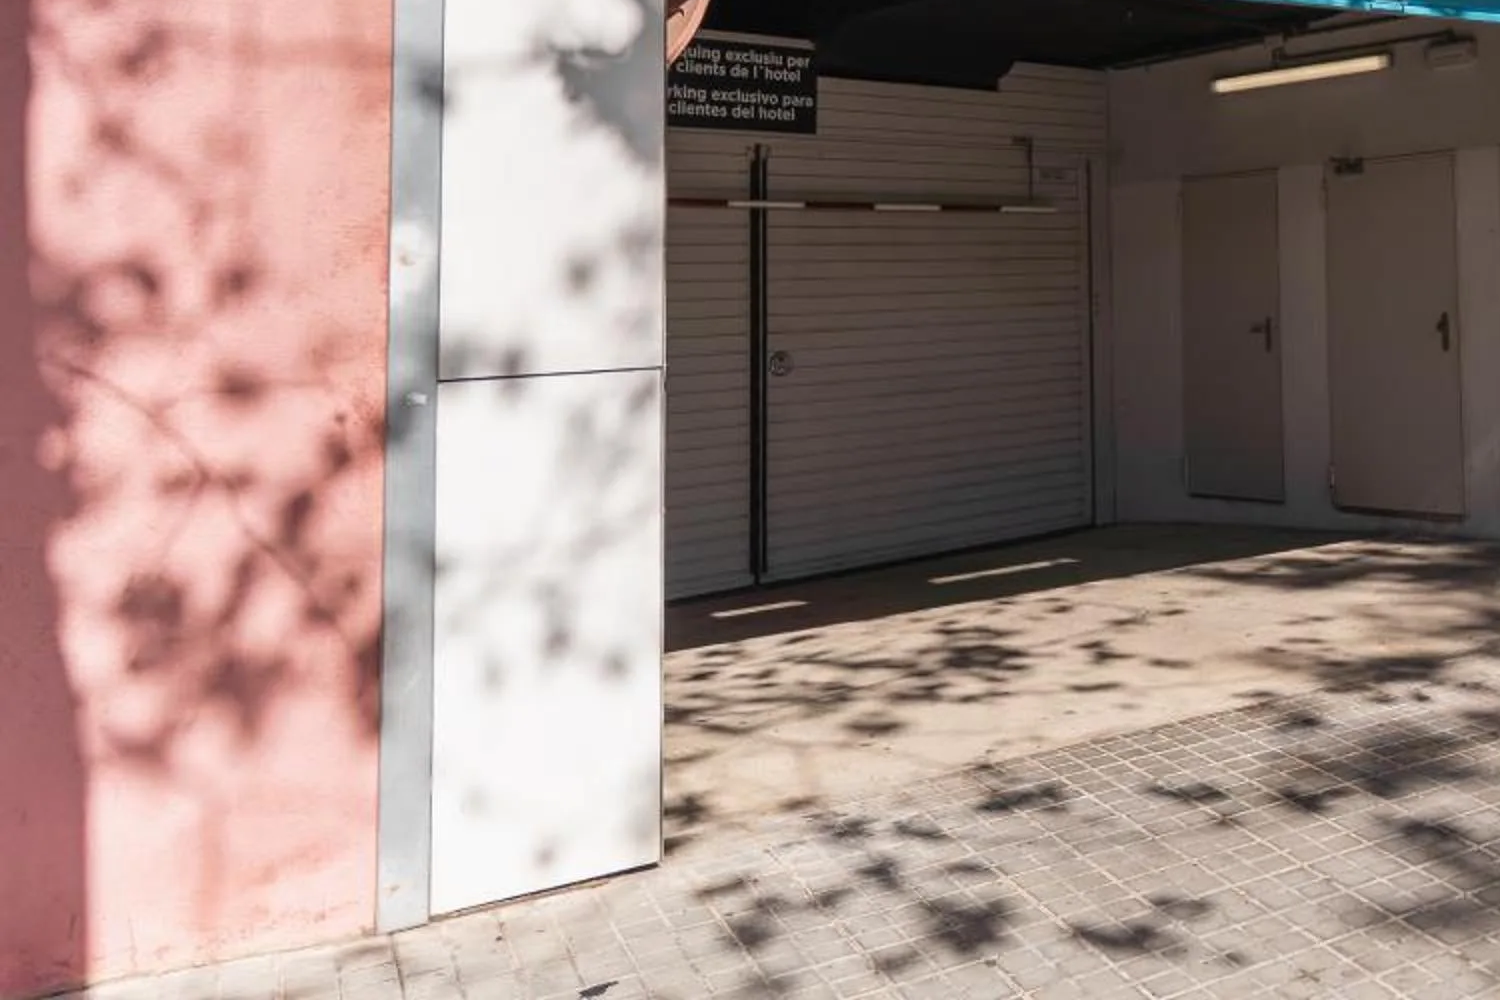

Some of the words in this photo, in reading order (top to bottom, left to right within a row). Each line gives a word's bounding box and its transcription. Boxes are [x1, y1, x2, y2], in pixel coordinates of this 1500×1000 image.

[725, 48, 783, 66] exclusiu
[786, 56, 810, 69] per
[676, 60, 727, 77] clients
[729, 64, 749, 78] de
[711, 88, 779, 105] exclusivo
[781, 94, 814, 107] para
[668, 101, 727, 117] clientes
[731, 104, 756, 119] del
[758, 105, 796, 121] hotel
